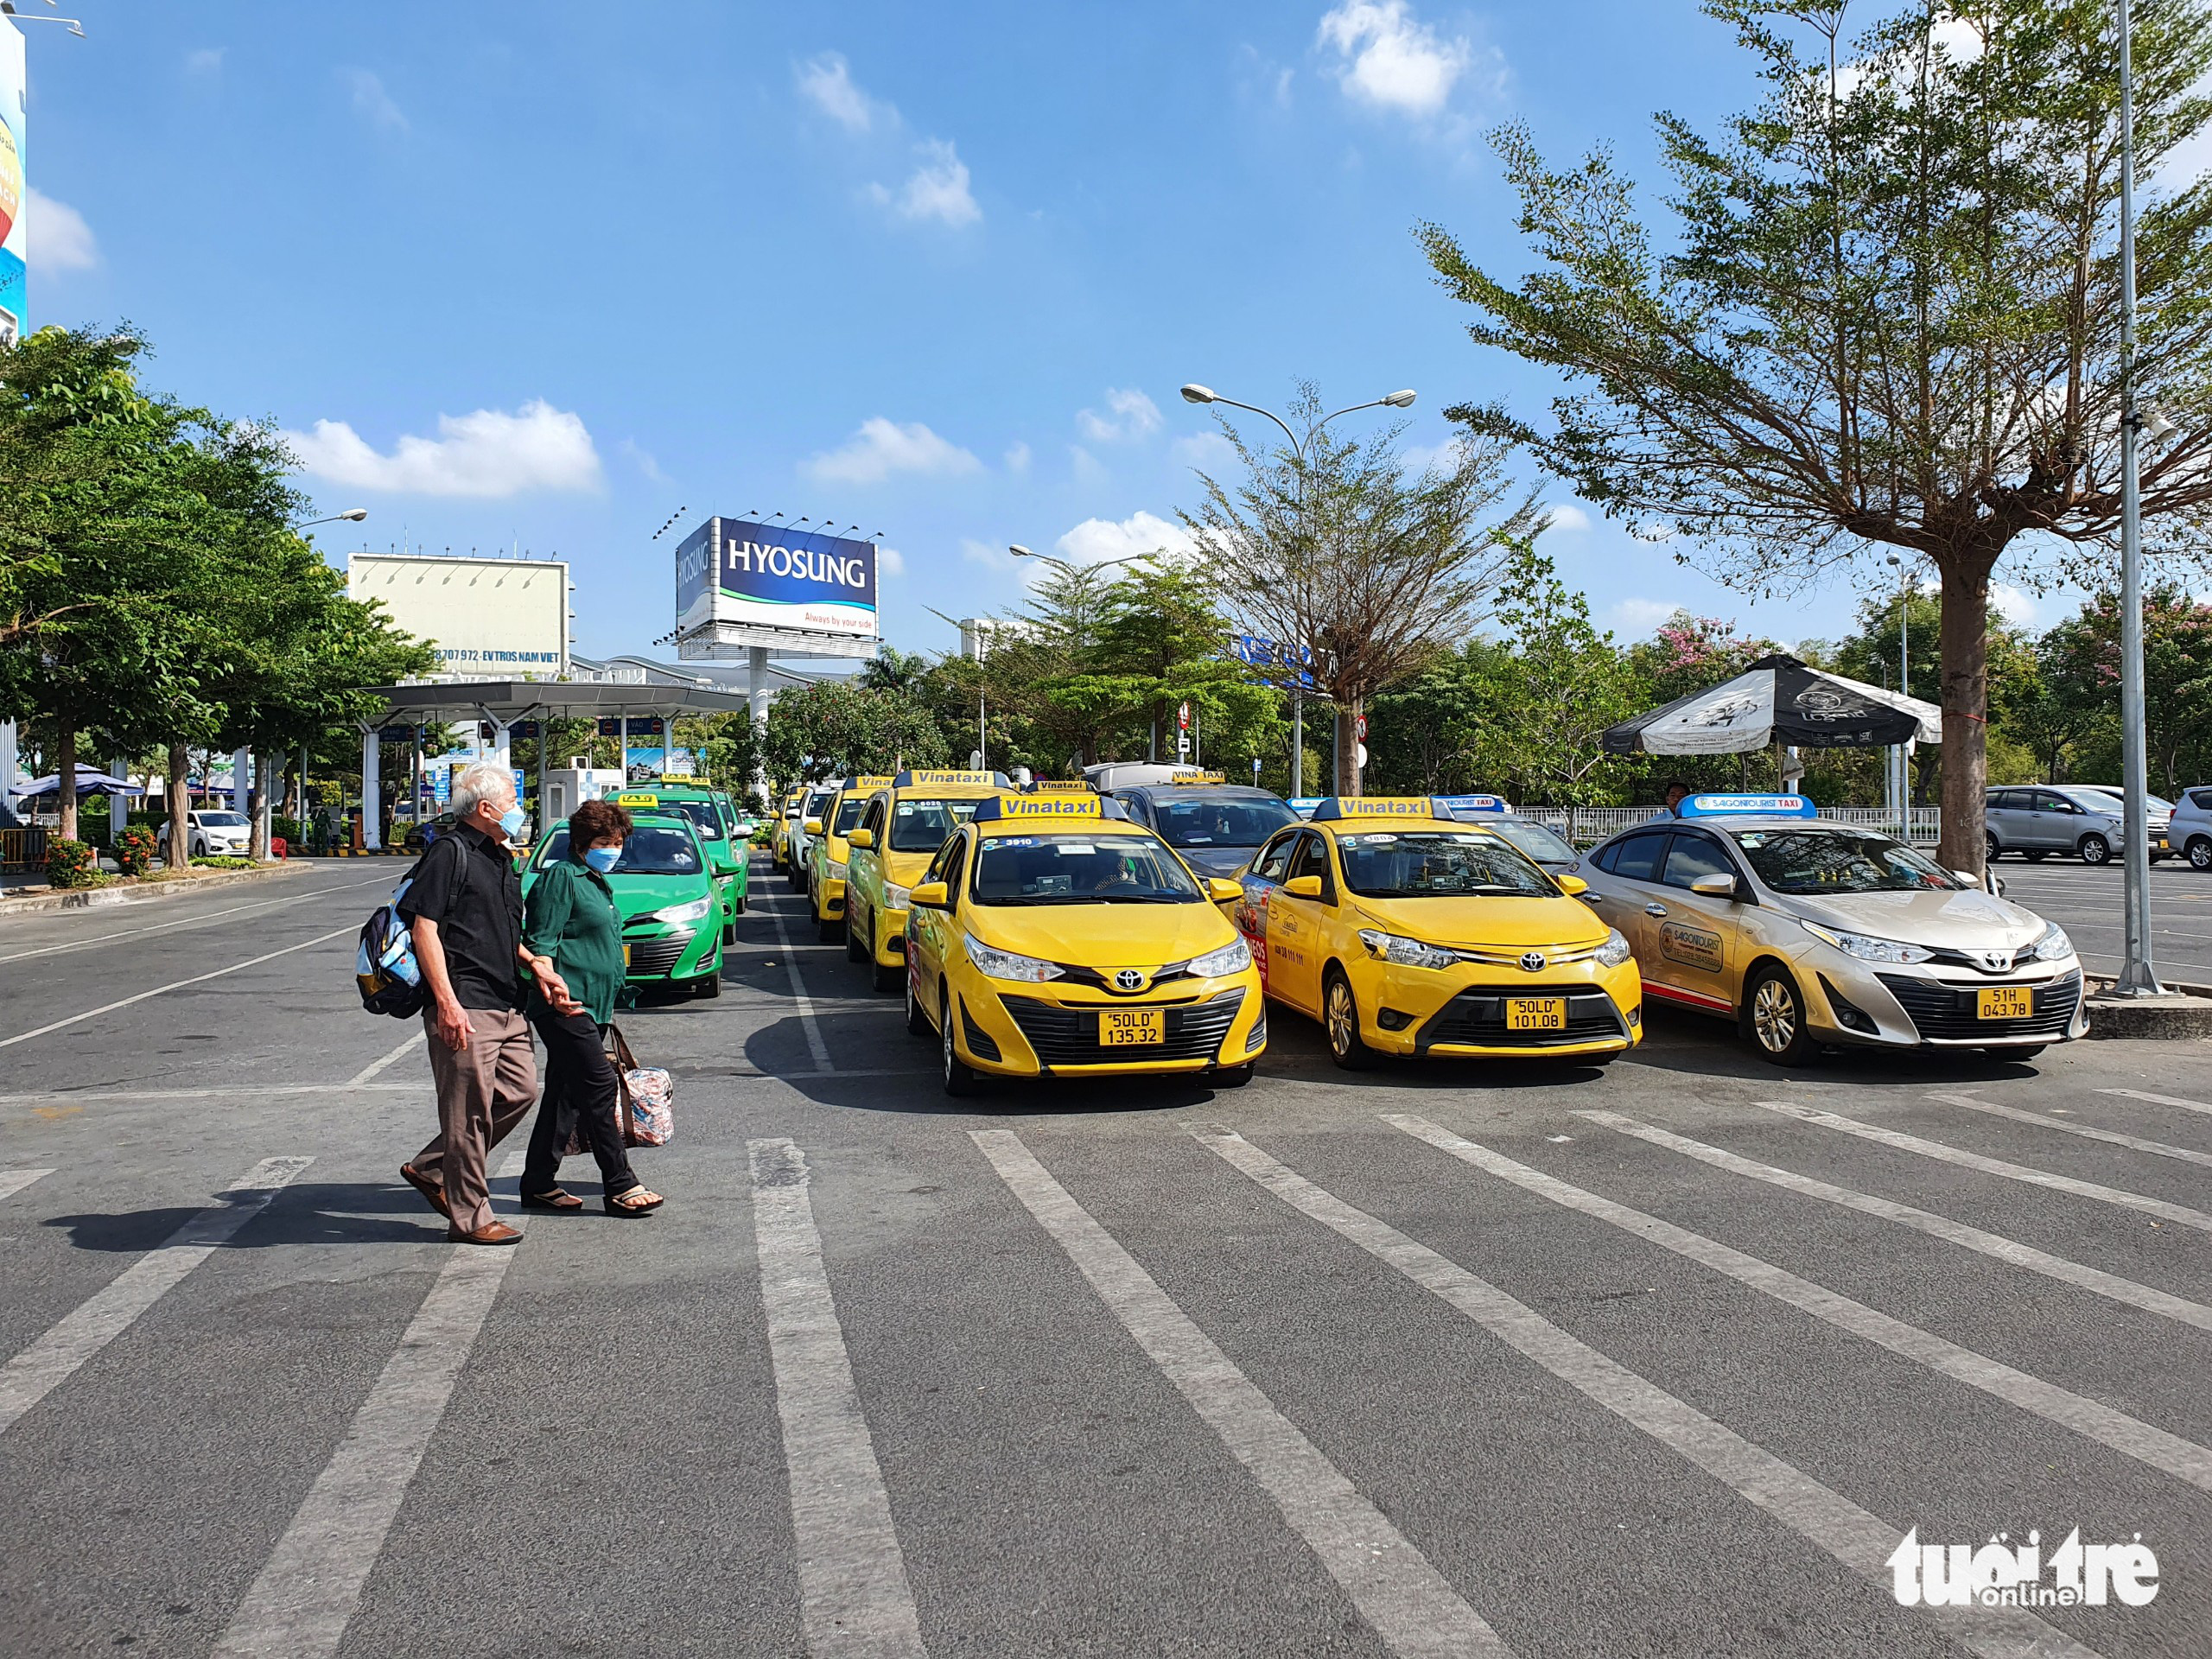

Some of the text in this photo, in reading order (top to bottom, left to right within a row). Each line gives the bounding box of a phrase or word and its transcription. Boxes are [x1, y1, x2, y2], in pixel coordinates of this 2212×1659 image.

[728, 539, 866, 588] HYOSUNG
[805, 612, 872, 628] Always by your side
[518, 652, 539, 662] NAM
[540, 652, 559, 663] VIET
[862, 777, 891, 786] Vina
[918, 772, 988, 783] Vinataxi
[1005, 799, 1096, 814] Vinataxi
[1343, 800, 1426, 814] Vinataxi
[1674, 930, 1719, 951] SAIGONTOURIST
[1247, 939, 1266, 960] NEOS
[1993, 989, 2016, 1001] 51H
[1519, 1001, 1553, 1014] 50LD
[1984, 1003, 2026, 1016] 043.78
[1113, 1013, 1150, 1027] 50LD
[1515, 1014, 1559, 1027] 101.08
[1108, 1028, 1157, 1044] 135.32
